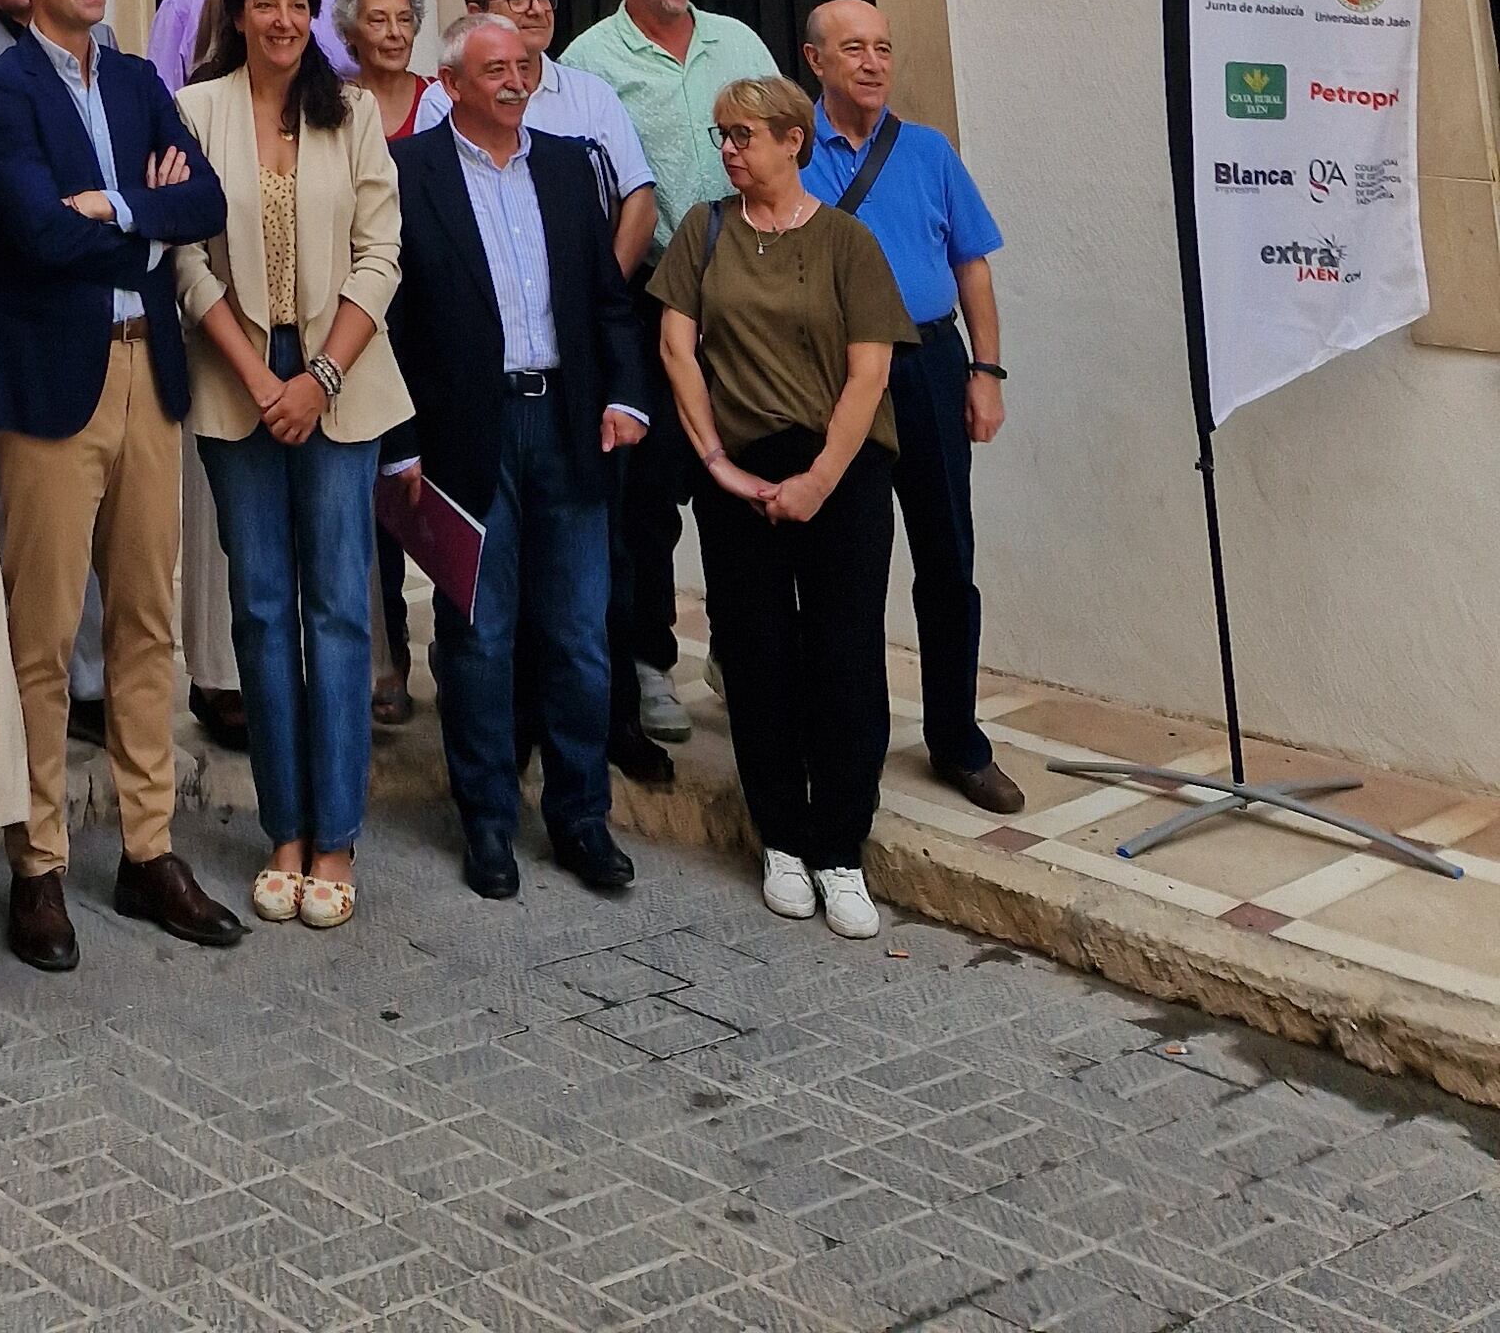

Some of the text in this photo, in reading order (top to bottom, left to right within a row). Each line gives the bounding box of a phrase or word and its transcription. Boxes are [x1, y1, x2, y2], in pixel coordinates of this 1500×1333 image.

[1205, 0, 1304, 16] Junta de Andalucía
[1372, 17, 1385, 26] de
[1310, 82, 1400, 110] Petropr
[1214, 161, 1294, 186] Blanca
[1261, 241, 1339, 267] extra
